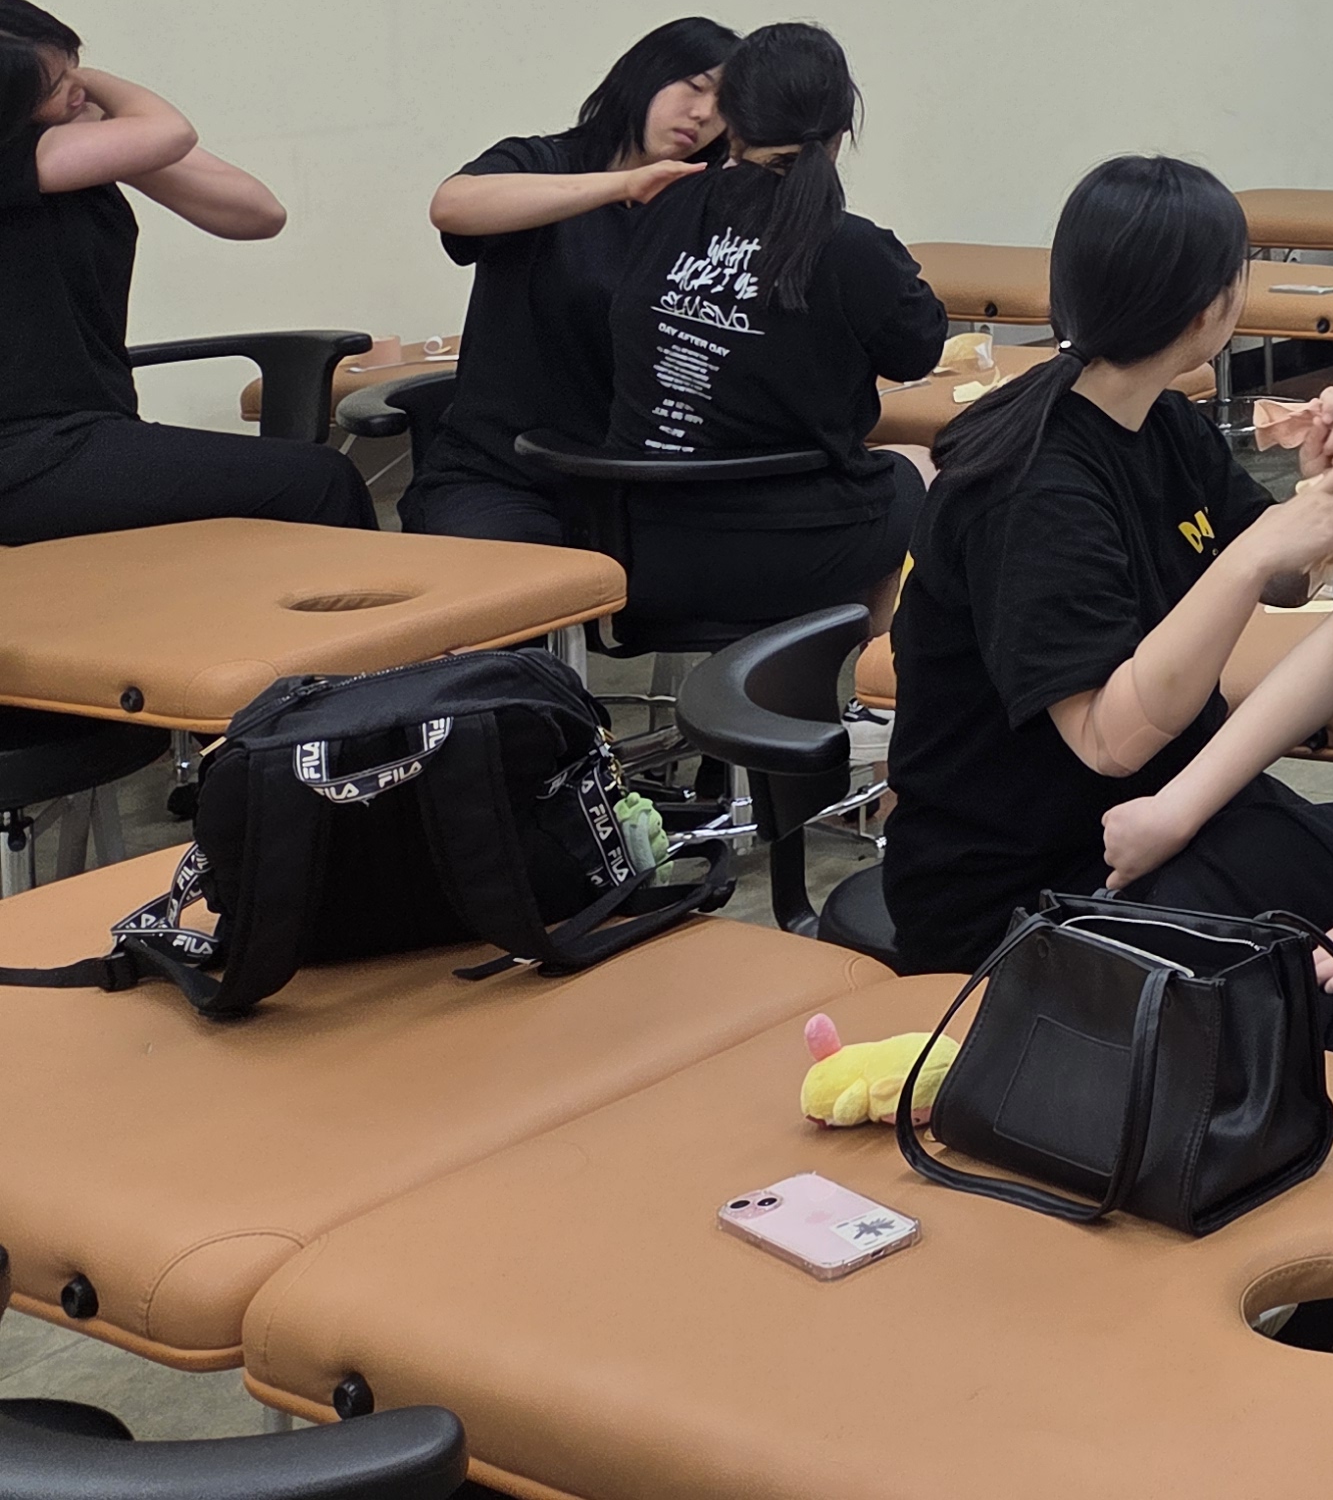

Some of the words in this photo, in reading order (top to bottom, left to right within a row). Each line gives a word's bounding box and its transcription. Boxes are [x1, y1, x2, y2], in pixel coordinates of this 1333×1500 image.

[707, 226, 762, 270] WHAT
[658, 322, 679, 337] DAY
[677, 331, 709, 349] AFTER
[708, 343, 731, 357] DAY
[302, 741, 321, 779] FILA
[377, 760, 423, 788] FILA
[589, 803, 614, 841] FILA
[608, 846, 630, 883] FILA
[172, 934, 213, 955] FILA
